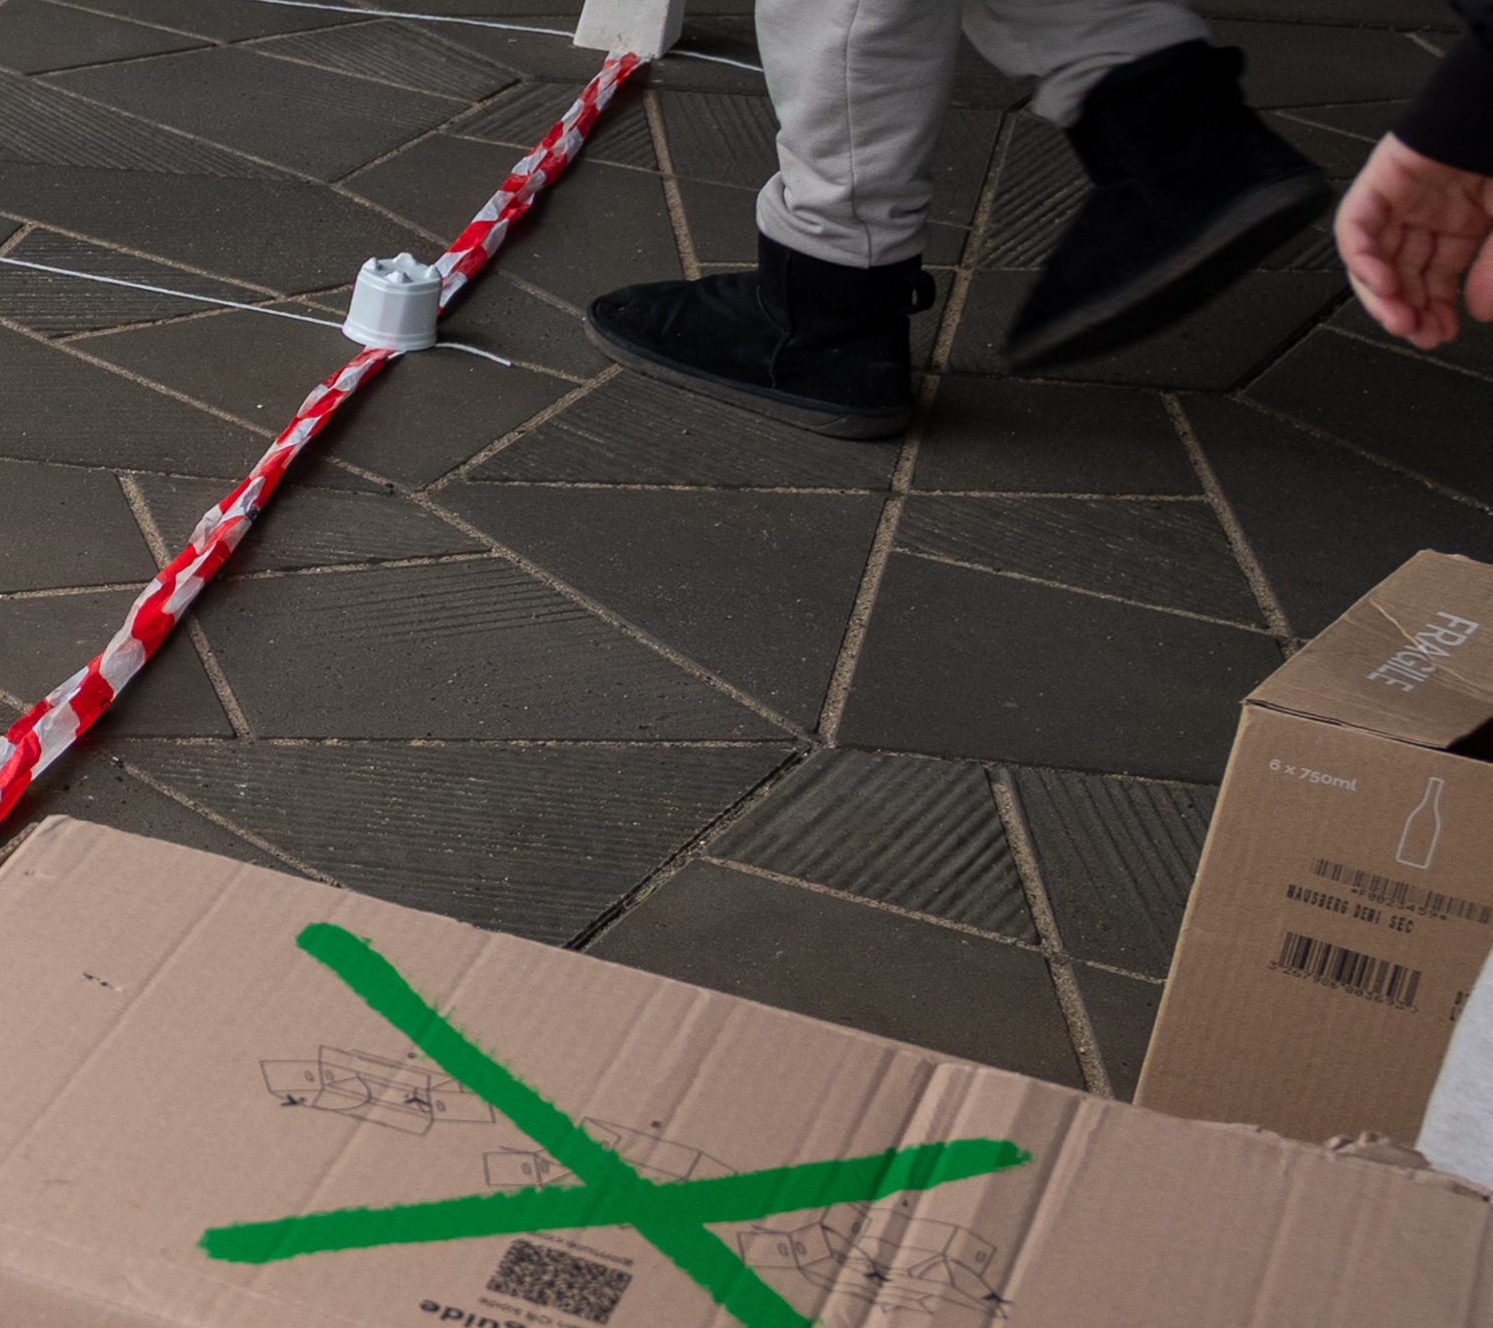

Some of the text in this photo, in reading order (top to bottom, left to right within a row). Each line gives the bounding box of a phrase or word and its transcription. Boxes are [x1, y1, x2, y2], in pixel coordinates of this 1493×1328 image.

[1365, 610, 1480, 693] FRAGILE
[1268, 758, 1358, 792] 6 x 750ml
[1388, 915, 1415, 934] SEC
